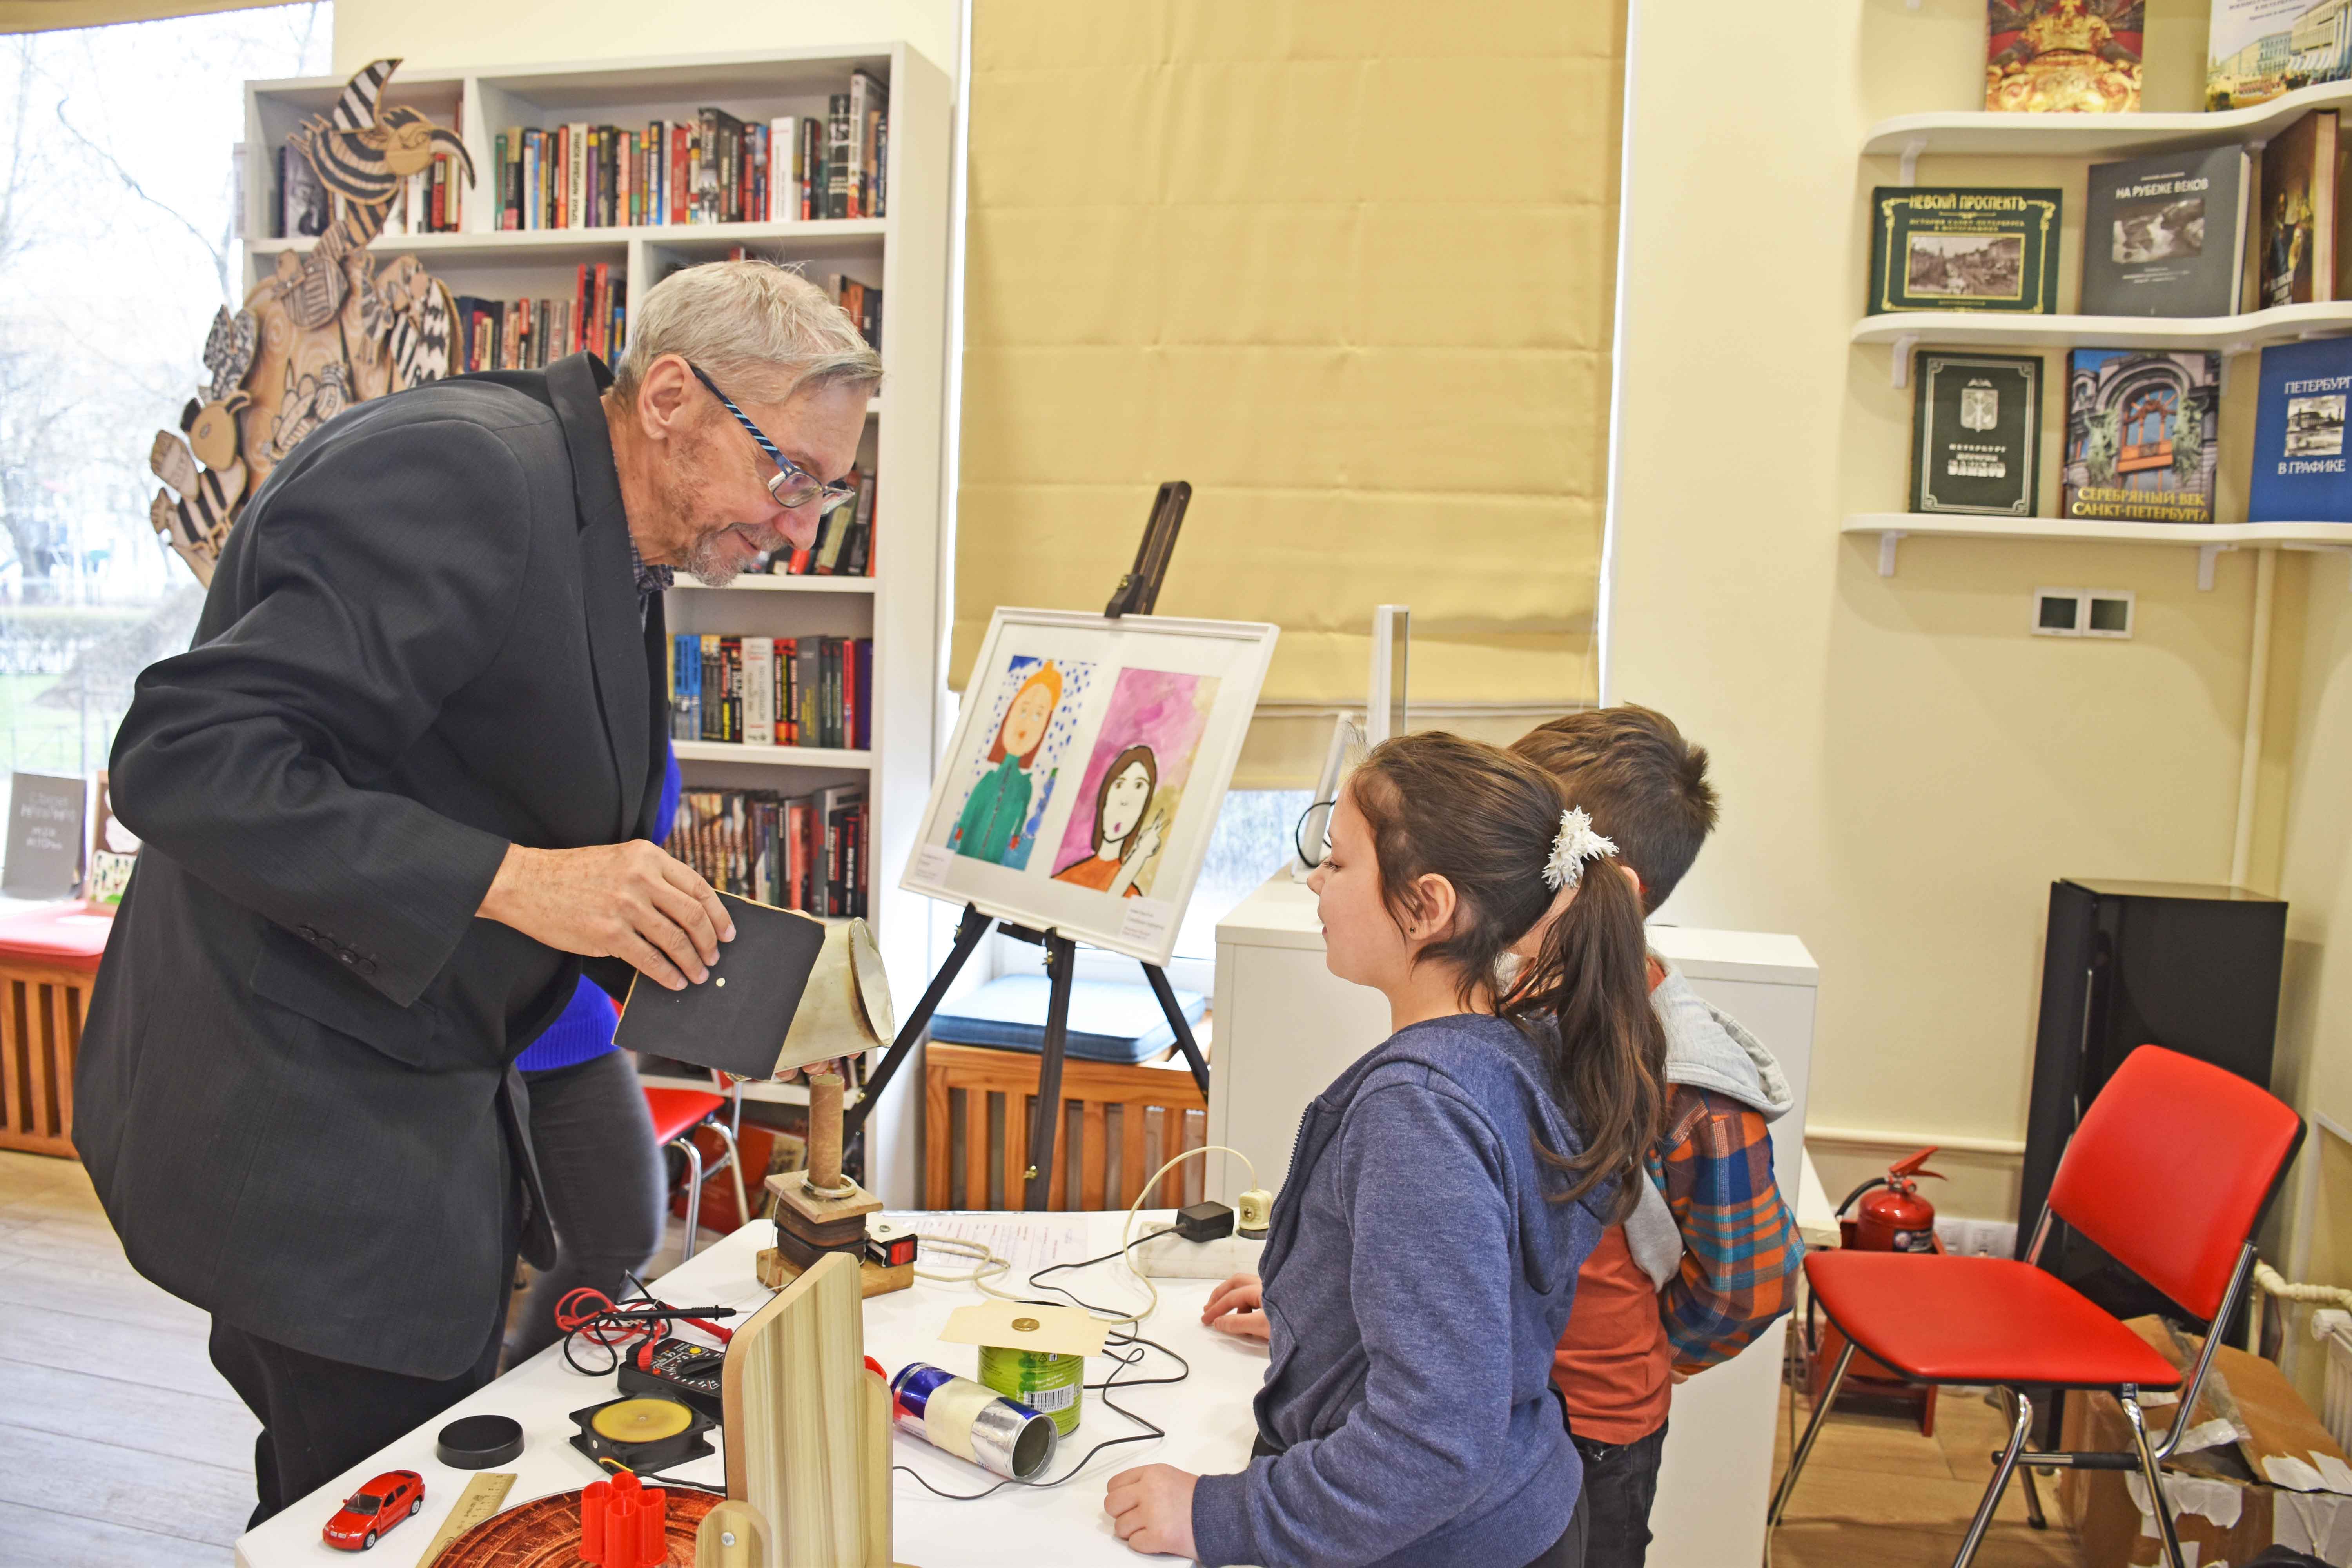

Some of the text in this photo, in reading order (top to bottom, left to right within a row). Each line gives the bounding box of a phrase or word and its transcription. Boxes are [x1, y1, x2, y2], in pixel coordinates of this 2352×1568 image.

[2115, 178, 2209, 199] НА РУБЕЖЕ ВЕКОВ
[2285, 376, 2352, 395] ПЕТЕРБУРГ
[2277, 458, 2346, 475] В ГРАФИКЕ
[2078, 486, 2205, 506] СЕРЕБРЯНЫЙ ВЕК
[2072, 501, 2209, 522] САНКТ-ПЕТЕРБУРГА
